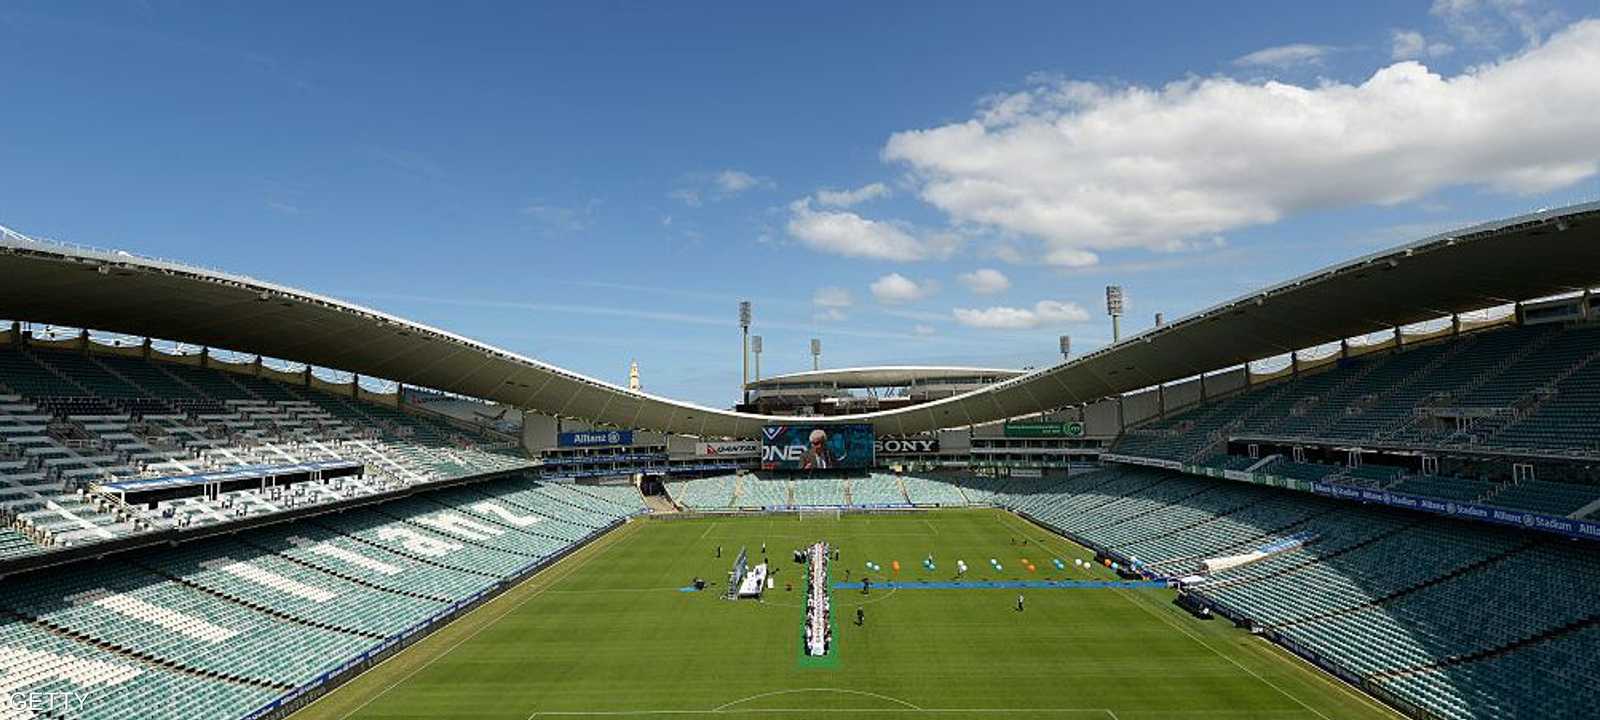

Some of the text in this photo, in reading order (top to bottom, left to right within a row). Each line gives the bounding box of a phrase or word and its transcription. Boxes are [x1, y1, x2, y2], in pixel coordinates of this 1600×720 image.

[574, 434, 608, 443] Allianz
[874, 440, 934, 452] SONY
[1493, 511, 1572, 531] Allianz Stadium
